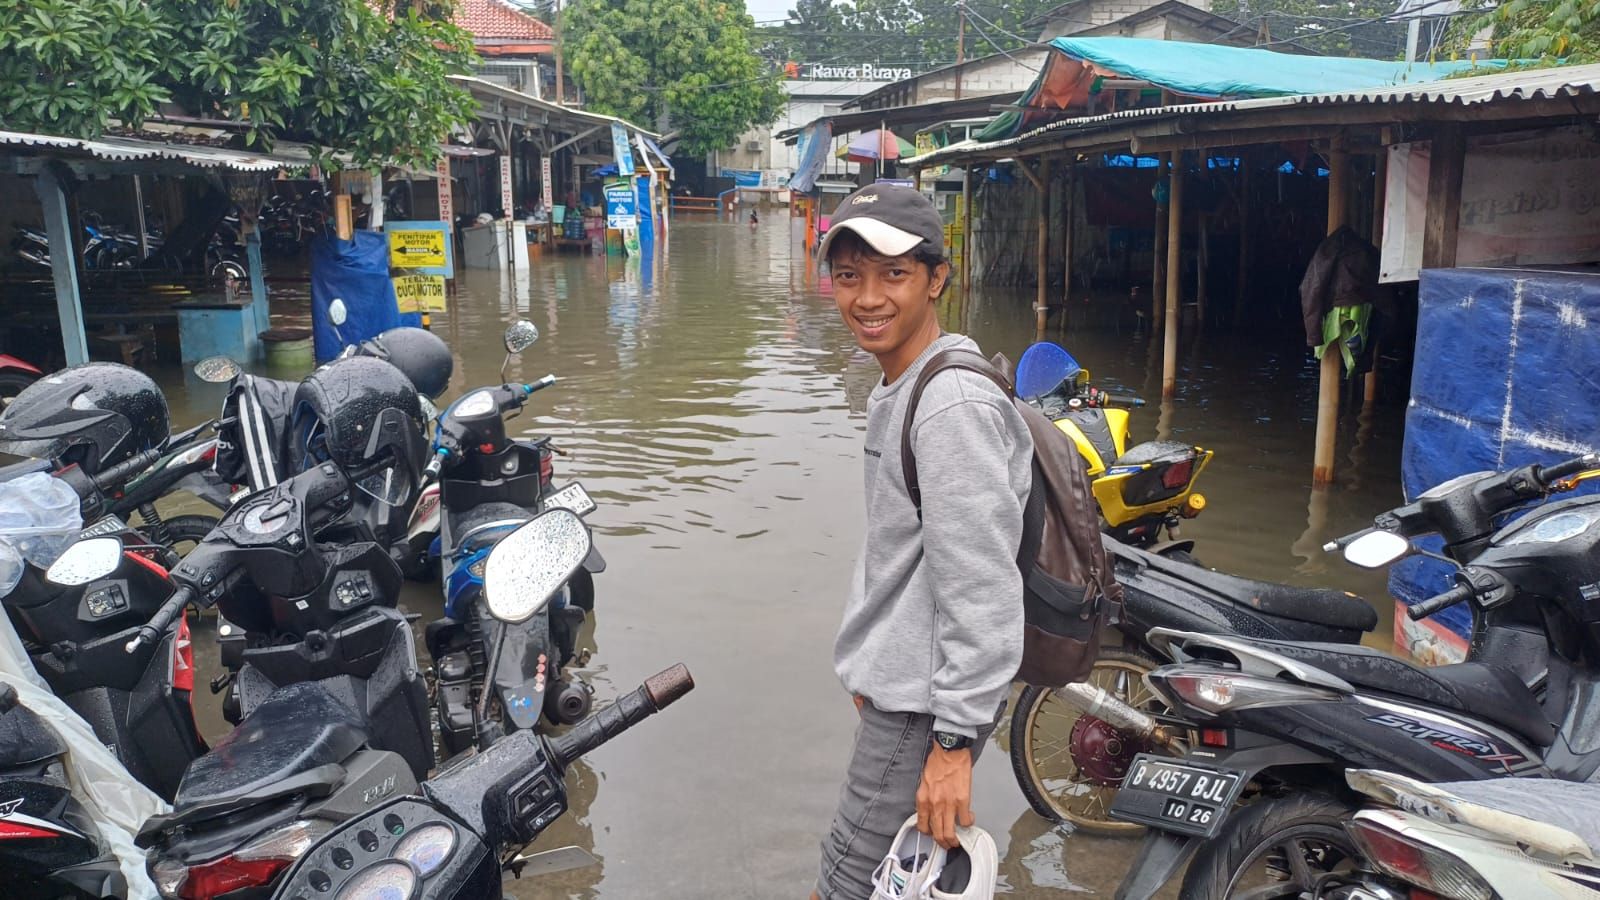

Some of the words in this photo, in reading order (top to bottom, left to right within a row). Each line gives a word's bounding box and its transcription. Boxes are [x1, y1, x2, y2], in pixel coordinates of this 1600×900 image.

[812, 63, 857, 79] Rawa
[861, 63, 912, 82] Buaya
[440, 193, 449, 220] MOTOR
[396, 284, 417, 298] CUCI
[417, 284, 442, 297] MOTOR
[1132, 766, 1148, 786] B
[1148, 769, 1191, 794] 4957
[1190, 775, 1226, 803] BJL
[1167, 802, 1185, 818] 10
[1189, 808, 1212, 824] 26
